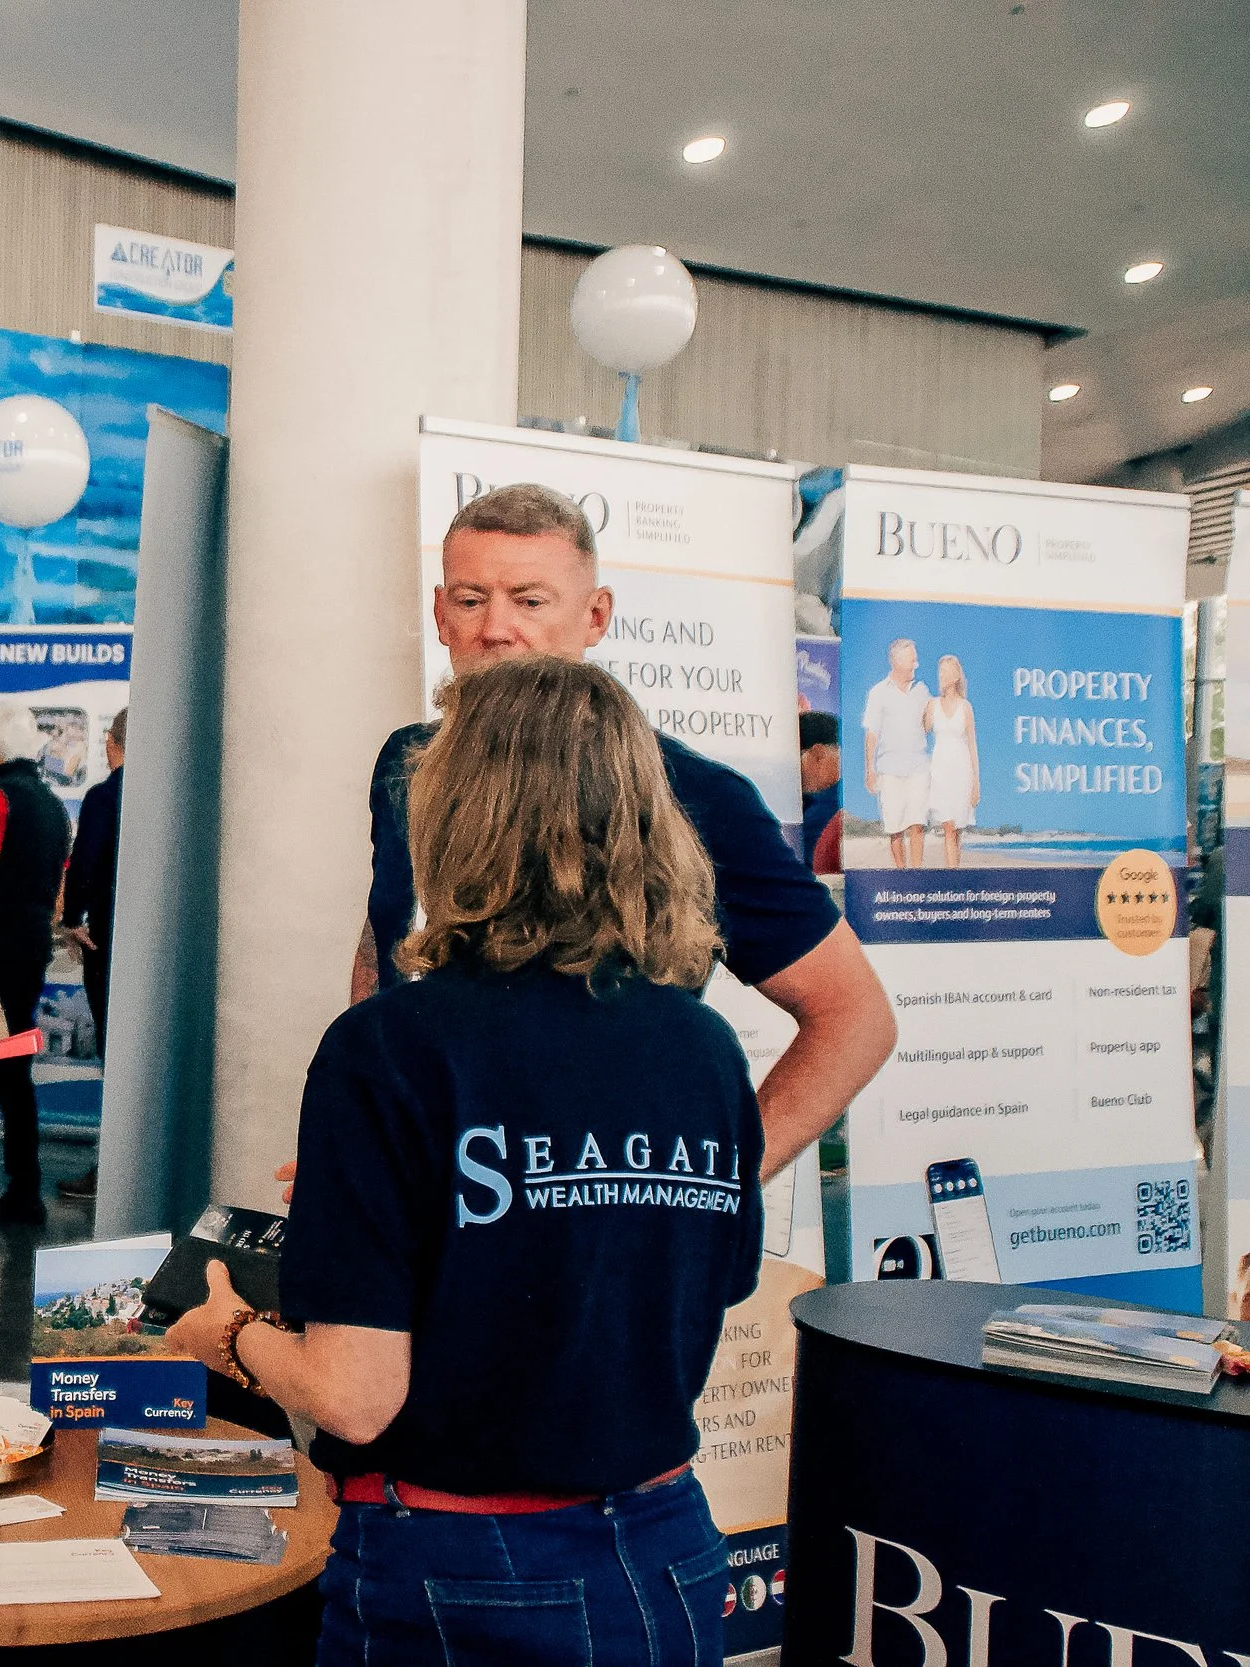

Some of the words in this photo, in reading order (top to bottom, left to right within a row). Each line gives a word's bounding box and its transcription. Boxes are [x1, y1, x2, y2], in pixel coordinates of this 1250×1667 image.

[877, 511, 1023, 565] BUENO
[662, 620, 714, 646] AND
[52, 643, 126, 664] BUILDS
[628, 662, 673, 689] FOR
[679, 666, 743, 693] YOUR
[1012, 667, 1152, 701] PROPERTY
[658, 709, 773, 738] PROPERTY
[1014, 716, 1154, 753] FINANCES,
[1014, 763, 1163, 795] SIMPLIFIED
[1120, 867, 1159, 884] Google
[927, 890, 965, 903] solution
[966, 889, 980, 902] for
[981, 890, 1014, 904] foreign
[1016, 891, 1056, 904] property
[918, 908, 950, 924] buyers
[951, 907, 969, 920] and
[970, 907, 1018, 922] long-term
[1019, 907, 1051, 919] renters
[896, 991, 942, 1008] Spanish
[944, 989, 970, 1004] IBAN
[972, 989, 1017, 1003] account
[1029, 988, 1053, 1001] card
[1088, 985, 1160, 998] Non-resident
[897, 1048, 965, 1065] Multilingual
[968, 1047, 990, 1063] app
[1001, 1045, 1045, 1060] support
[1090, 1040, 1137, 1055] Property
[1139, 1041, 1162, 1053] app
[1091, 1096, 1125, 1108] Bueno
[1127, 1094, 1153, 1106] Club
[900, 1106, 929, 1124] Legal
[932, 1104, 983, 1121] guidance
[984, 1103, 995, 1116] in
[998, 1102, 1029, 1116] Spain
[1009, 1220, 1122, 1250] getbueno.com
[722, 1322, 762, 1343] KING
[741, 1350, 772, 1369] FOR
[51, 1371, 100, 1388] Money
[51, 1387, 117, 1403] Transfers
[703, 1382, 738, 1405] ERTY
[741, 1376, 790, 1399] OWNE
[50, 1405, 63, 1419] in
[65, 1404, 105, 1421] Spain
[174, 1397, 195, 1409] Key
[724, 1409, 757, 1430] AND
[124, 1466, 177, 1479] Money
[126, 1472, 197, 1487] Transfers
[726, 1543, 780, 1568] NGUAGE
